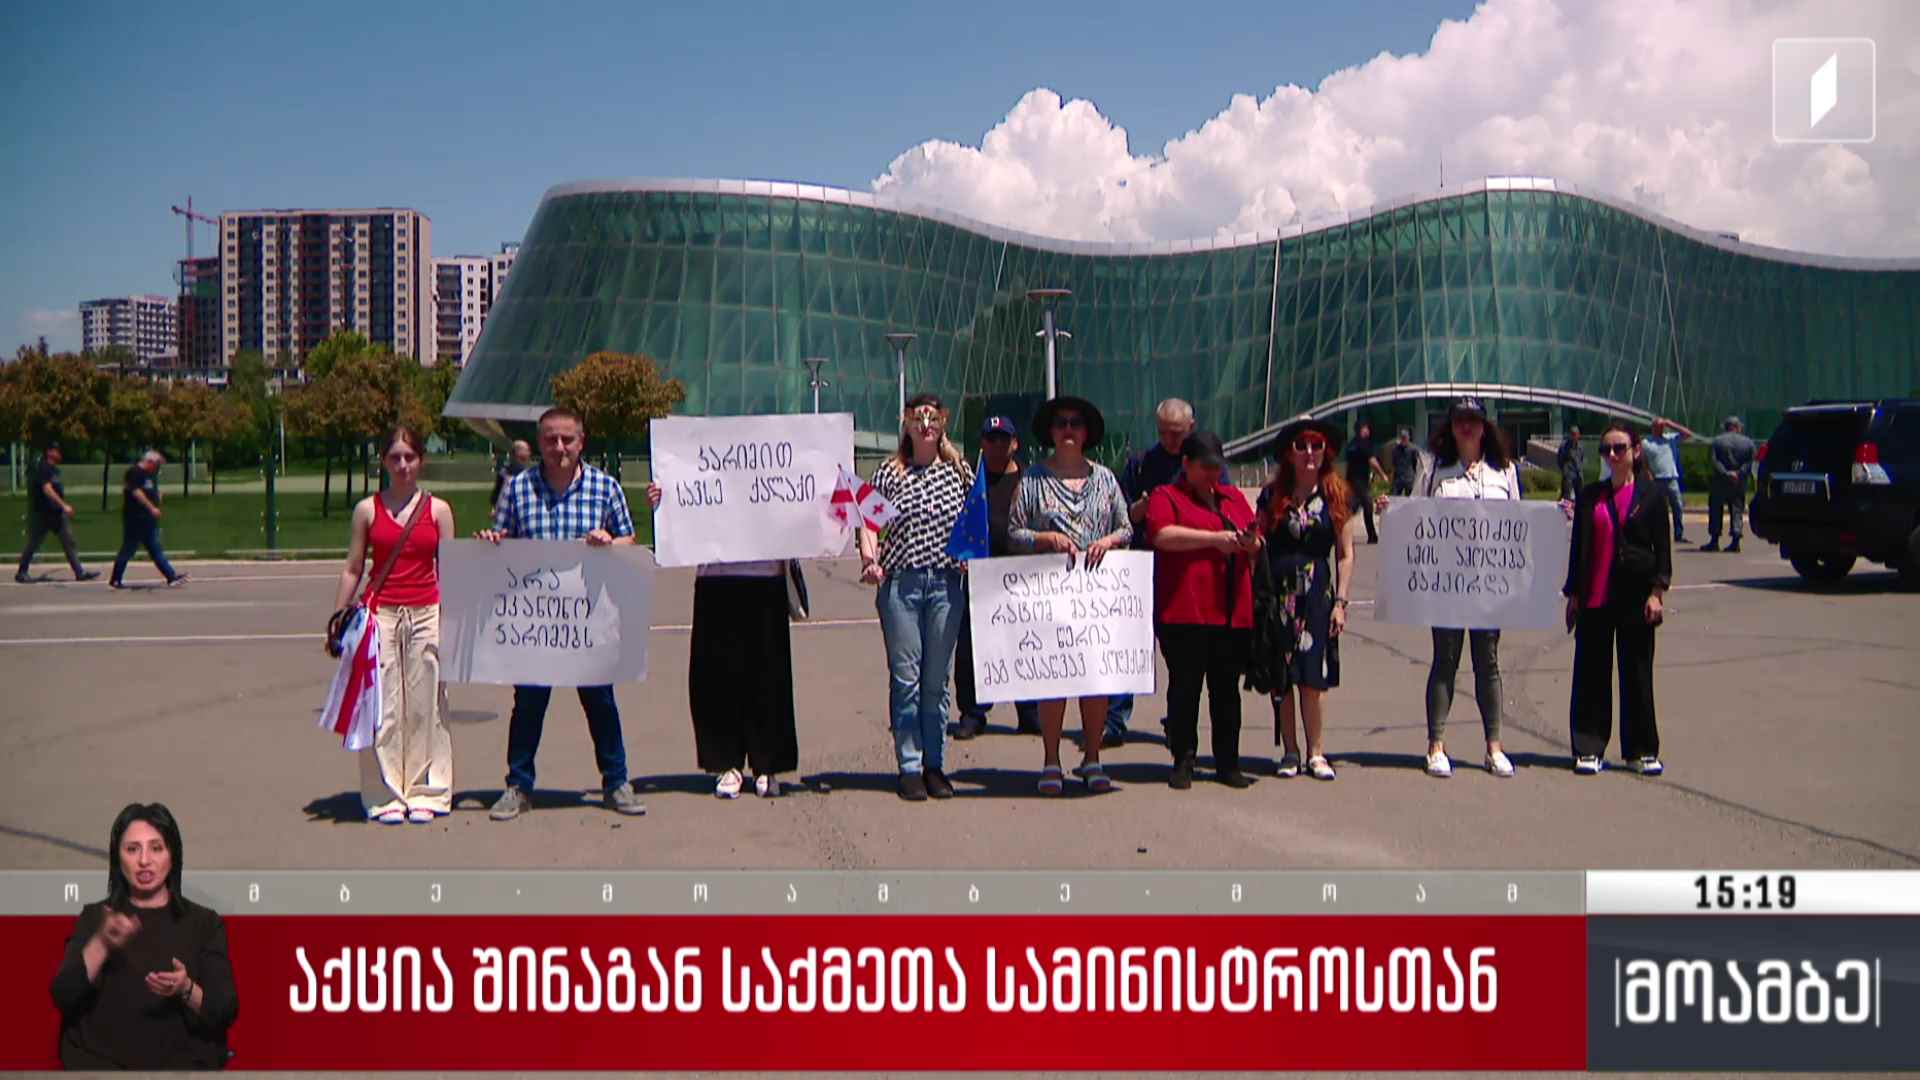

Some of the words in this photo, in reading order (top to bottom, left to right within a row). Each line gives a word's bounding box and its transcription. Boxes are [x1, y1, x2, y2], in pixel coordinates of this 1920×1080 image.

[698, 441, 792, 472] ჯარიმით
[676, 478, 723, 507] სავსე
[749, 473, 815, 503] ქალაქი
[1414, 516, 1529, 542] გაიღვიძეთ
[507, 567, 560, 591] არა
[494, 594, 591, 619] უკანონო
[991, 599, 1054, 625] რატომ
[495, 623, 593, 648] ჯარიმებს
[1019, 631, 1043, 651] რა
[1056, 624, 1111, 649] წერია
[984, 659, 1009, 686] მაგ
